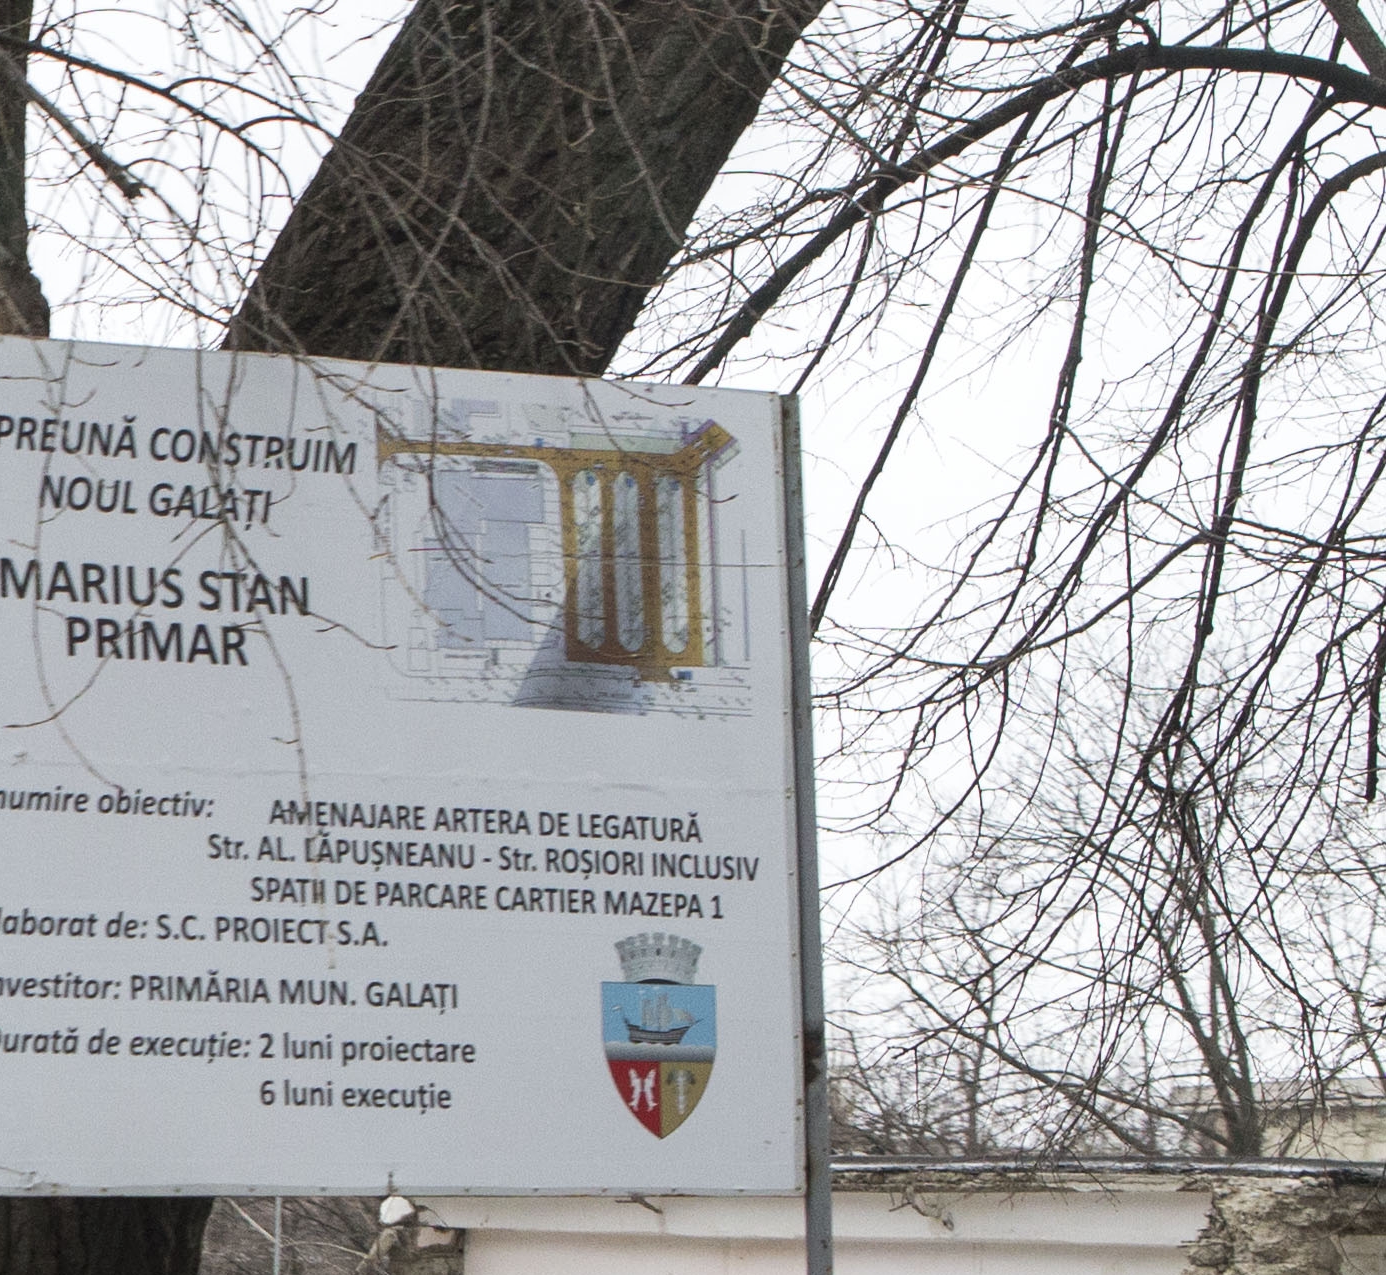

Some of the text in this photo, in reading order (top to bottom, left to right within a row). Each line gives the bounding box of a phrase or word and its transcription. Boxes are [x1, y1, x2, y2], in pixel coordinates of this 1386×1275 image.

[149, 427, 359, 475] CONSTRUIM
[39, 474, 272, 531] NOUL GALAȚI
[0, 557, 309, 616] MARIUS STAN
[65, 616, 248, 667] PRIMAR
[97, 785, 215, 818] obiectiv:
[269, 799, 703, 843] AMENAJARE ARTERA DE LEGATURĂ
[207, 833, 249, 861] Str.
[256, 835, 295, 862] AL.
[304, 830, 476, 872] LĂPUȘNEANU
[498, 846, 537, 872] Str.
[545, 848, 645, 881] ROȘIORI
[652, 853, 760, 882] INCLUSIV
[334, 880, 367, 906] DE
[375, 881, 488, 911] PARCARE
[494, 886, 597, 915] CARTIER
[604, 890, 704, 919] MAZEPA
[711, 894, 725, 920] 1
[105, 911, 149, 940] de:
[156, 913, 206, 941] S.C.
[214, 916, 329, 945] PROIECT
[337, 920, 389, 947] S.A.
[129, 969, 271, 1004] PRIMĂRIA
[279, 978, 356, 1007] MUN.
[365, 981, 458, 1016] GALAȚI
[87, 1027, 122, 1056] de
[129, 1030, 251, 1064] execuție:
[259, 1032, 274, 1060] 2
[282, 1032, 333, 1062] luni
[341, 1035, 476, 1068] proiectare
[259, 1079, 451, 1115] 6 luni execuție
